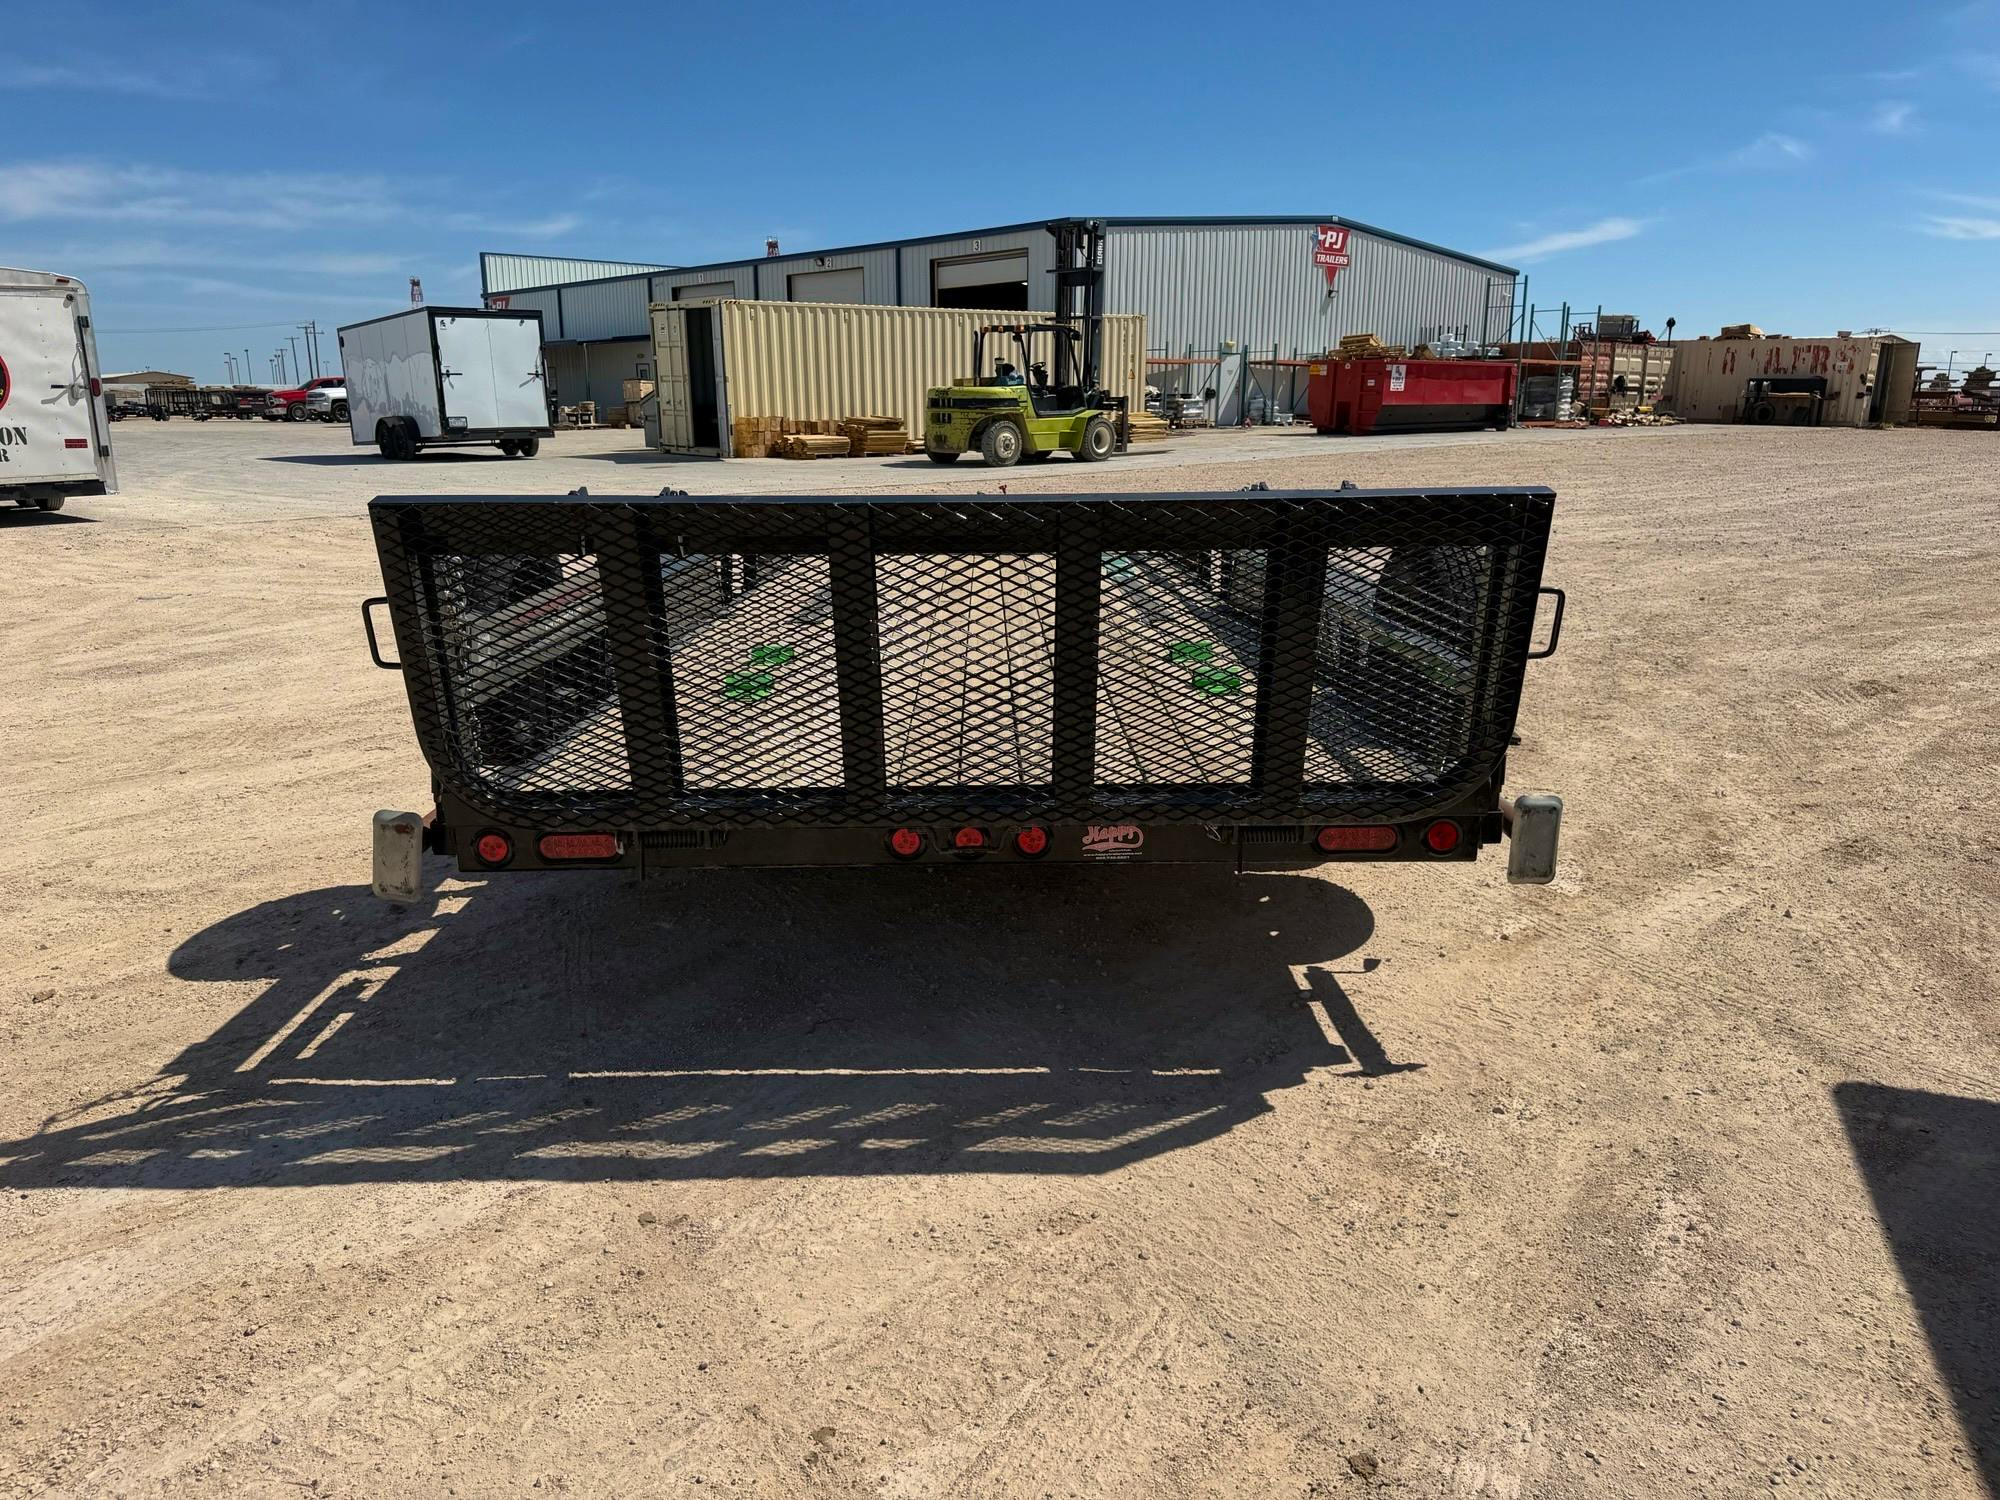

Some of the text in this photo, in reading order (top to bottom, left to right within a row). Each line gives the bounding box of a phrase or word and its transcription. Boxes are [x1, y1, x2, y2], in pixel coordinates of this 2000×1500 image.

[1324, 230, 1344, 249] PJ
[1096, 239, 1104, 265] CLARK
[1316, 254, 1348, 265] TRAILERS
[1082, 825, 1144, 850] Happy
